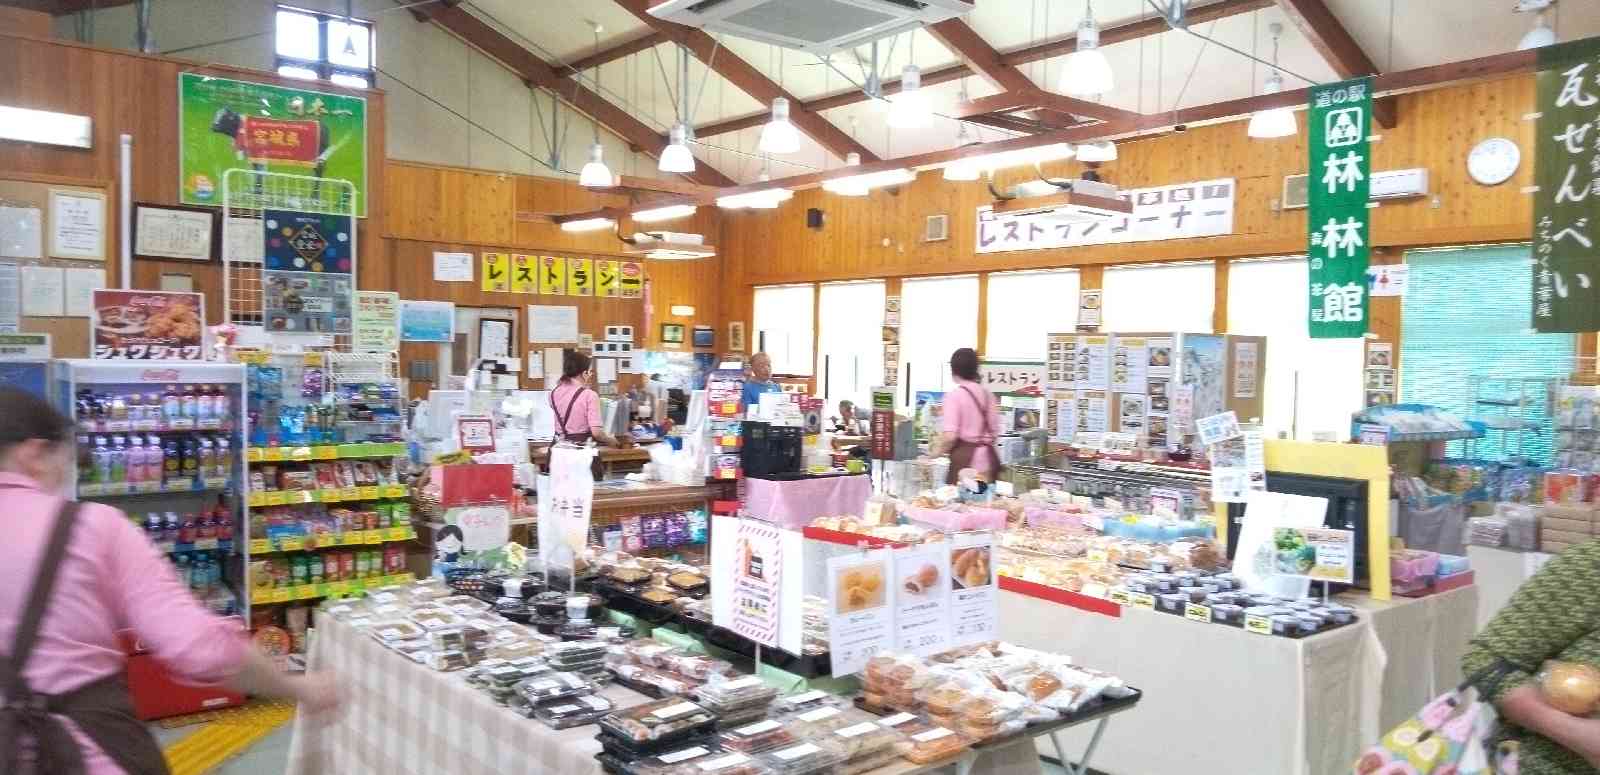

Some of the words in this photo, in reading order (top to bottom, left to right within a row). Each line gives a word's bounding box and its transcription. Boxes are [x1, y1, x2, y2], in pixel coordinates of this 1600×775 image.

[1315, 83, 1366, 108] 道の駅
[1553, 62, 1599, 299] 瓦せんべい
[1322, 150, 1364, 322] 林林館
